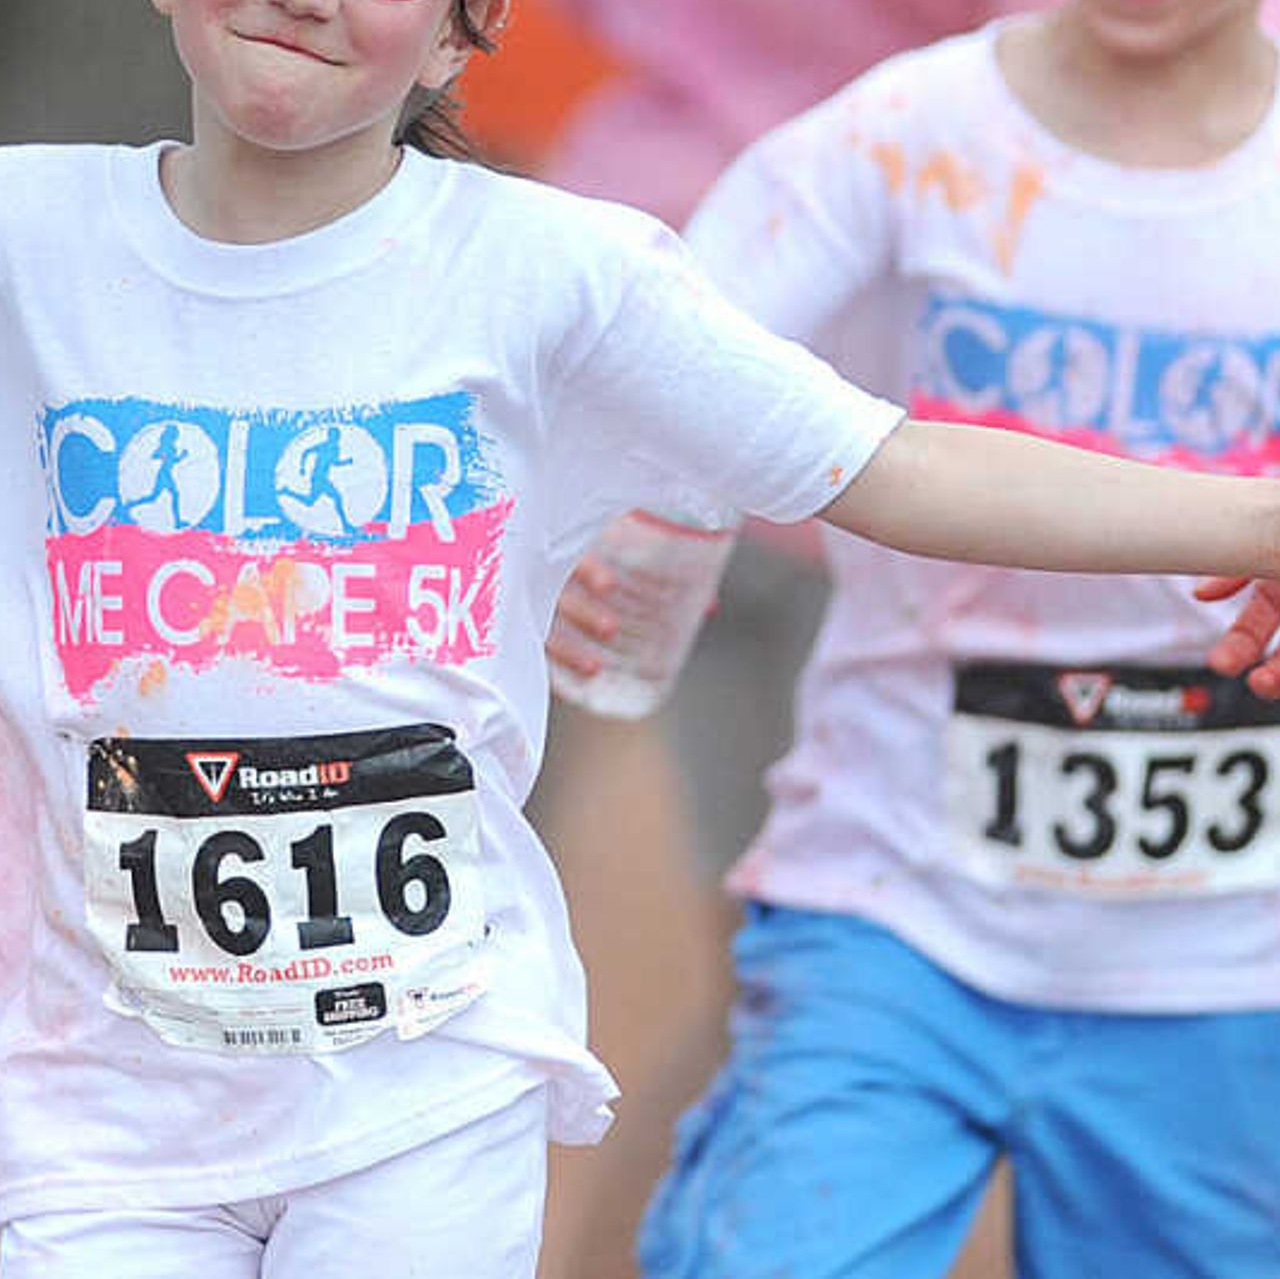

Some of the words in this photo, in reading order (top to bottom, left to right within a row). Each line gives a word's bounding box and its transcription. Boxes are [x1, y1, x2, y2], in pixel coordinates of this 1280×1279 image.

[49, 413, 463, 543] COLOR
[55, 560, 123, 645] ME
[146, 559, 377, 647] CAPE
[405, 565, 483, 653] 5K
[982, 741, 1269, 860] 1353
[119, 810, 452, 957] 1616
[169, 951, 394, 984] www.RoadID.com
